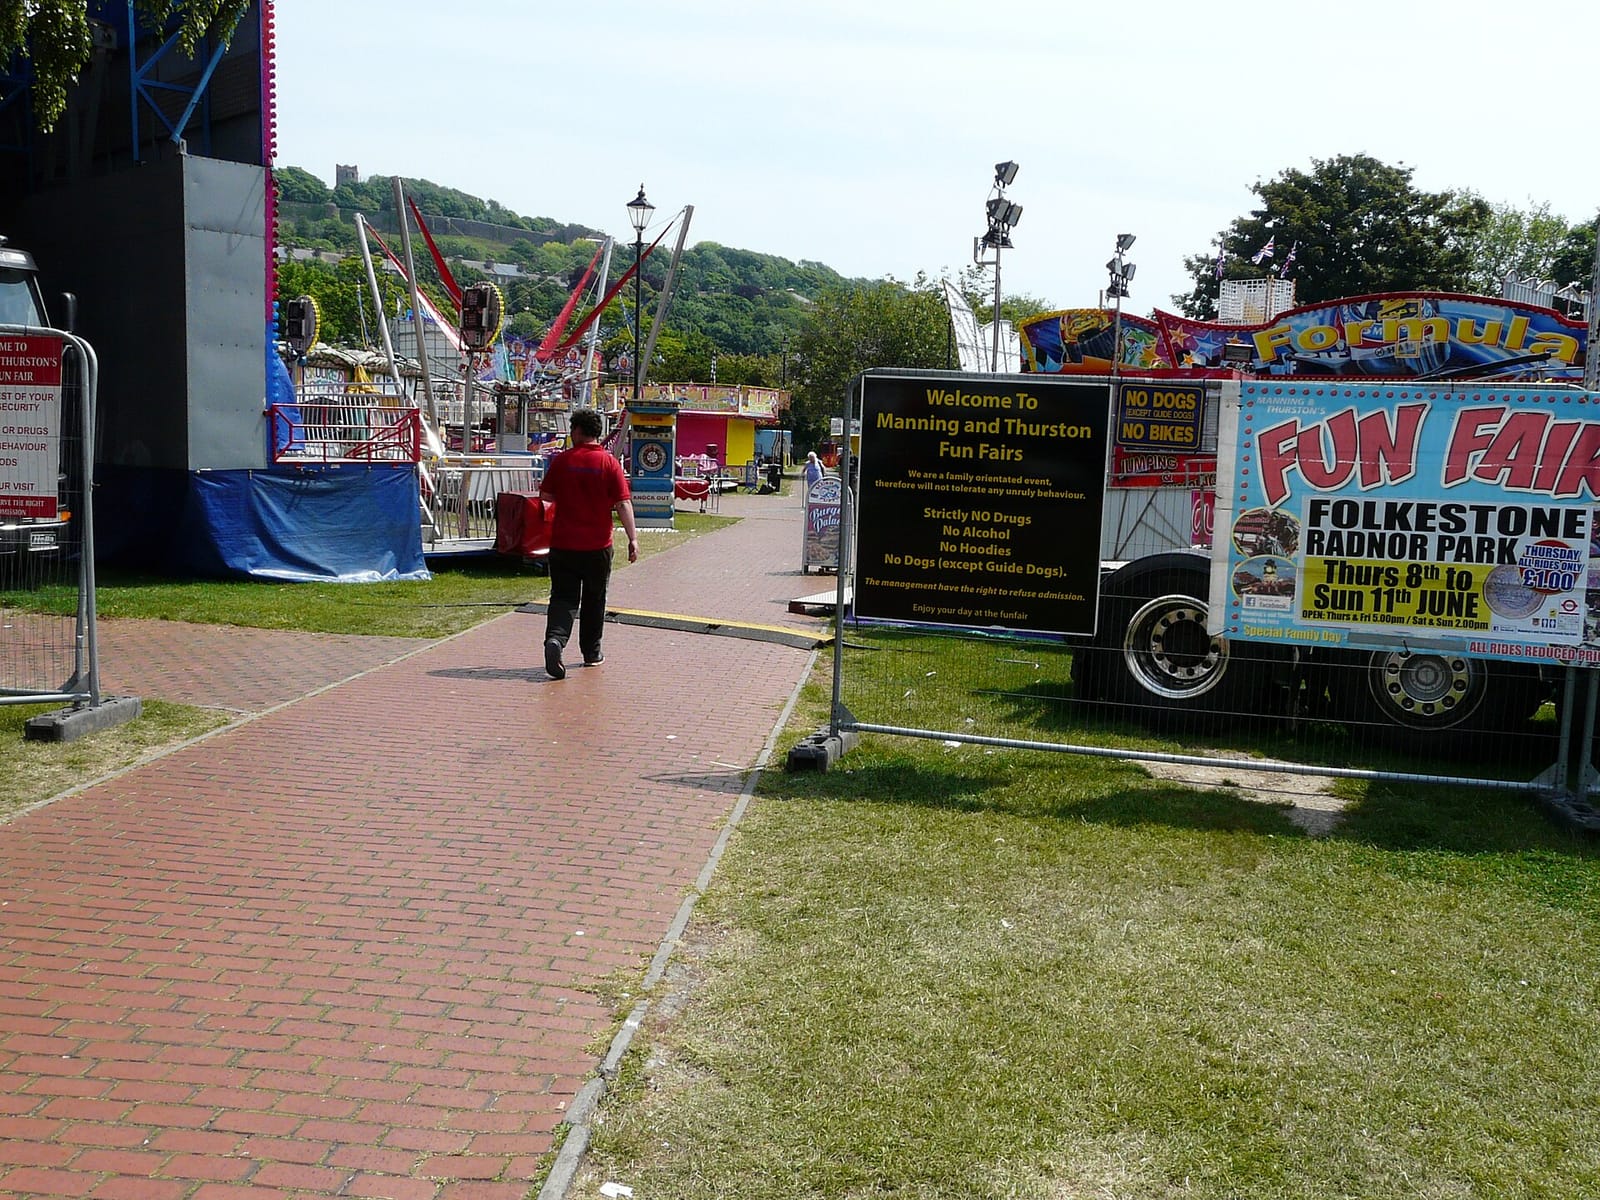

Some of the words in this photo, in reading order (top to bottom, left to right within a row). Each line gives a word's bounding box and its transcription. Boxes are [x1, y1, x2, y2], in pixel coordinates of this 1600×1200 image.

[15, 342, 27, 352] TO
[1252, 315, 1579, 363] Formula
[0, 356, 58, 367] THURSTON'S
[14, 371, 33, 382] FAIR
[15, 392, 26, 400] OF
[29, 393, 54, 401] YOUR
[926, 389, 1012, 408] Welcome
[1016, 393, 1038, 410] To
[1126, 390, 1148, 407] NO
[1153, 391, 1196, 410] DOGS
[1256, 396, 1305, 405] MANNING
[1126, 408, 1151, 417] (EXCEPT
[1153, 410, 1171, 418] GUIDE
[1173, 411, 1194, 419] DOGS)
[1267, 405, 1326, 415] THURSTON'S
[2, 426, 15, 434] OR
[17, 427, 48, 435] DRUGS
[876, 412, 959, 436] Manning
[964, 417, 1000, 434] and
[1004, 418, 1092, 438] Thurston
[1123, 423, 1145, 439] NO
[1150, 424, 1194, 443] BIKES
[939, 441, 973, 458] Fun
[978, 443, 1023, 461] Fairs
[1256, 404, 1430, 507] FUN
[1119, 454, 1178, 480] JUMPING
[13, 482, 35, 491] VISIT
[908, 469, 922, 478] We
[946, 472, 974, 483] family
[975, 474, 1023, 484] orientated
[1024, 478, 1052, 486] event,
[874, 480, 915, 489] therefore
[917, 482, 933, 490] will
[951, 485, 986, 493] tolerate
[987, 488, 1004, 496] any
[1006, 487, 1036, 498] unruly
[1037, 489, 1086, 500] behaviour.
[923, 507, 968, 522] Strictly
[971, 510, 990, 521] NO
[993, 512, 1032, 526] Drugs
[1308, 499, 1586, 538] FOLKESTONE
[943, 525, 960, 536] No
[962, 527, 1010, 540] Alcohol
[940, 541, 957, 552] No
[959, 543, 1011, 556] Hoodies
[1306, 529, 1428, 560] RADNOR
[1436, 534, 1519, 565] PARK
[1525, 545, 1580, 561] THURSDAY
[884, 553, 901, 565] No
[904, 555, 935, 568] Dogs
[938, 557, 983, 572] (except
[986, 561, 1023, 573] Guide
[1026, 564, 1067, 578] Dogs).
[1519, 557, 1532, 567] ALL
[1534, 559, 1559, 570] RIDES
[1561, 562, 1583, 572] ONLY
[1324, 560, 1399, 588] Thurs
[1406, 563, 1440, 588] 8th
[1446, 567, 1473, 591] to
[1522, 569, 1574, 591] £1.00
[864, 577, 880, 586] The
[881, 580, 937, 591] management
[938, 582, 959, 592] have
[960, 585, 974, 593] the
[975, 585, 997, 596] right
[1009, 588, 1037, 598] refuse
[1038, 590, 1085, 601] admission.
[913, 603, 935, 615] Enjoy
[937, 607, 956, 616] your
[957, 607, 973, 617] day
[984, 609, 998, 617] the
[1000, 610, 1028, 620] funfair
[1314, 584, 1363, 611] Sun
[1370, 587, 1411, 613] 11th
[1416, 590, 1479, 619] JUNE
[1302, 610, 1325, 619] OPEN:
[1327, 612, 1350, 621] Thurs
[1360, 613, 1371, 622] Fri
[1372, 614, 1404, 625] 5.00pm
[1406, 615, 1411, 624] /
[1412, 617, 1426, 625] Sat
[1428, 618, 1434, 626] &
[1436, 618, 1453, 627] Sun
[1455, 619, 1488, 630] 2.00pm
[1244, 624, 1283, 637] Special
[1286, 628, 1319, 642] Family
[1322, 630, 1342, 643] Day
[1470, 641, 1487, 653] ALL
[1490, 643, 1521, 655] RIDES
[1525, 645, 1576, 660] REDUCED
[1578, 648, 1600, 661] PRI
